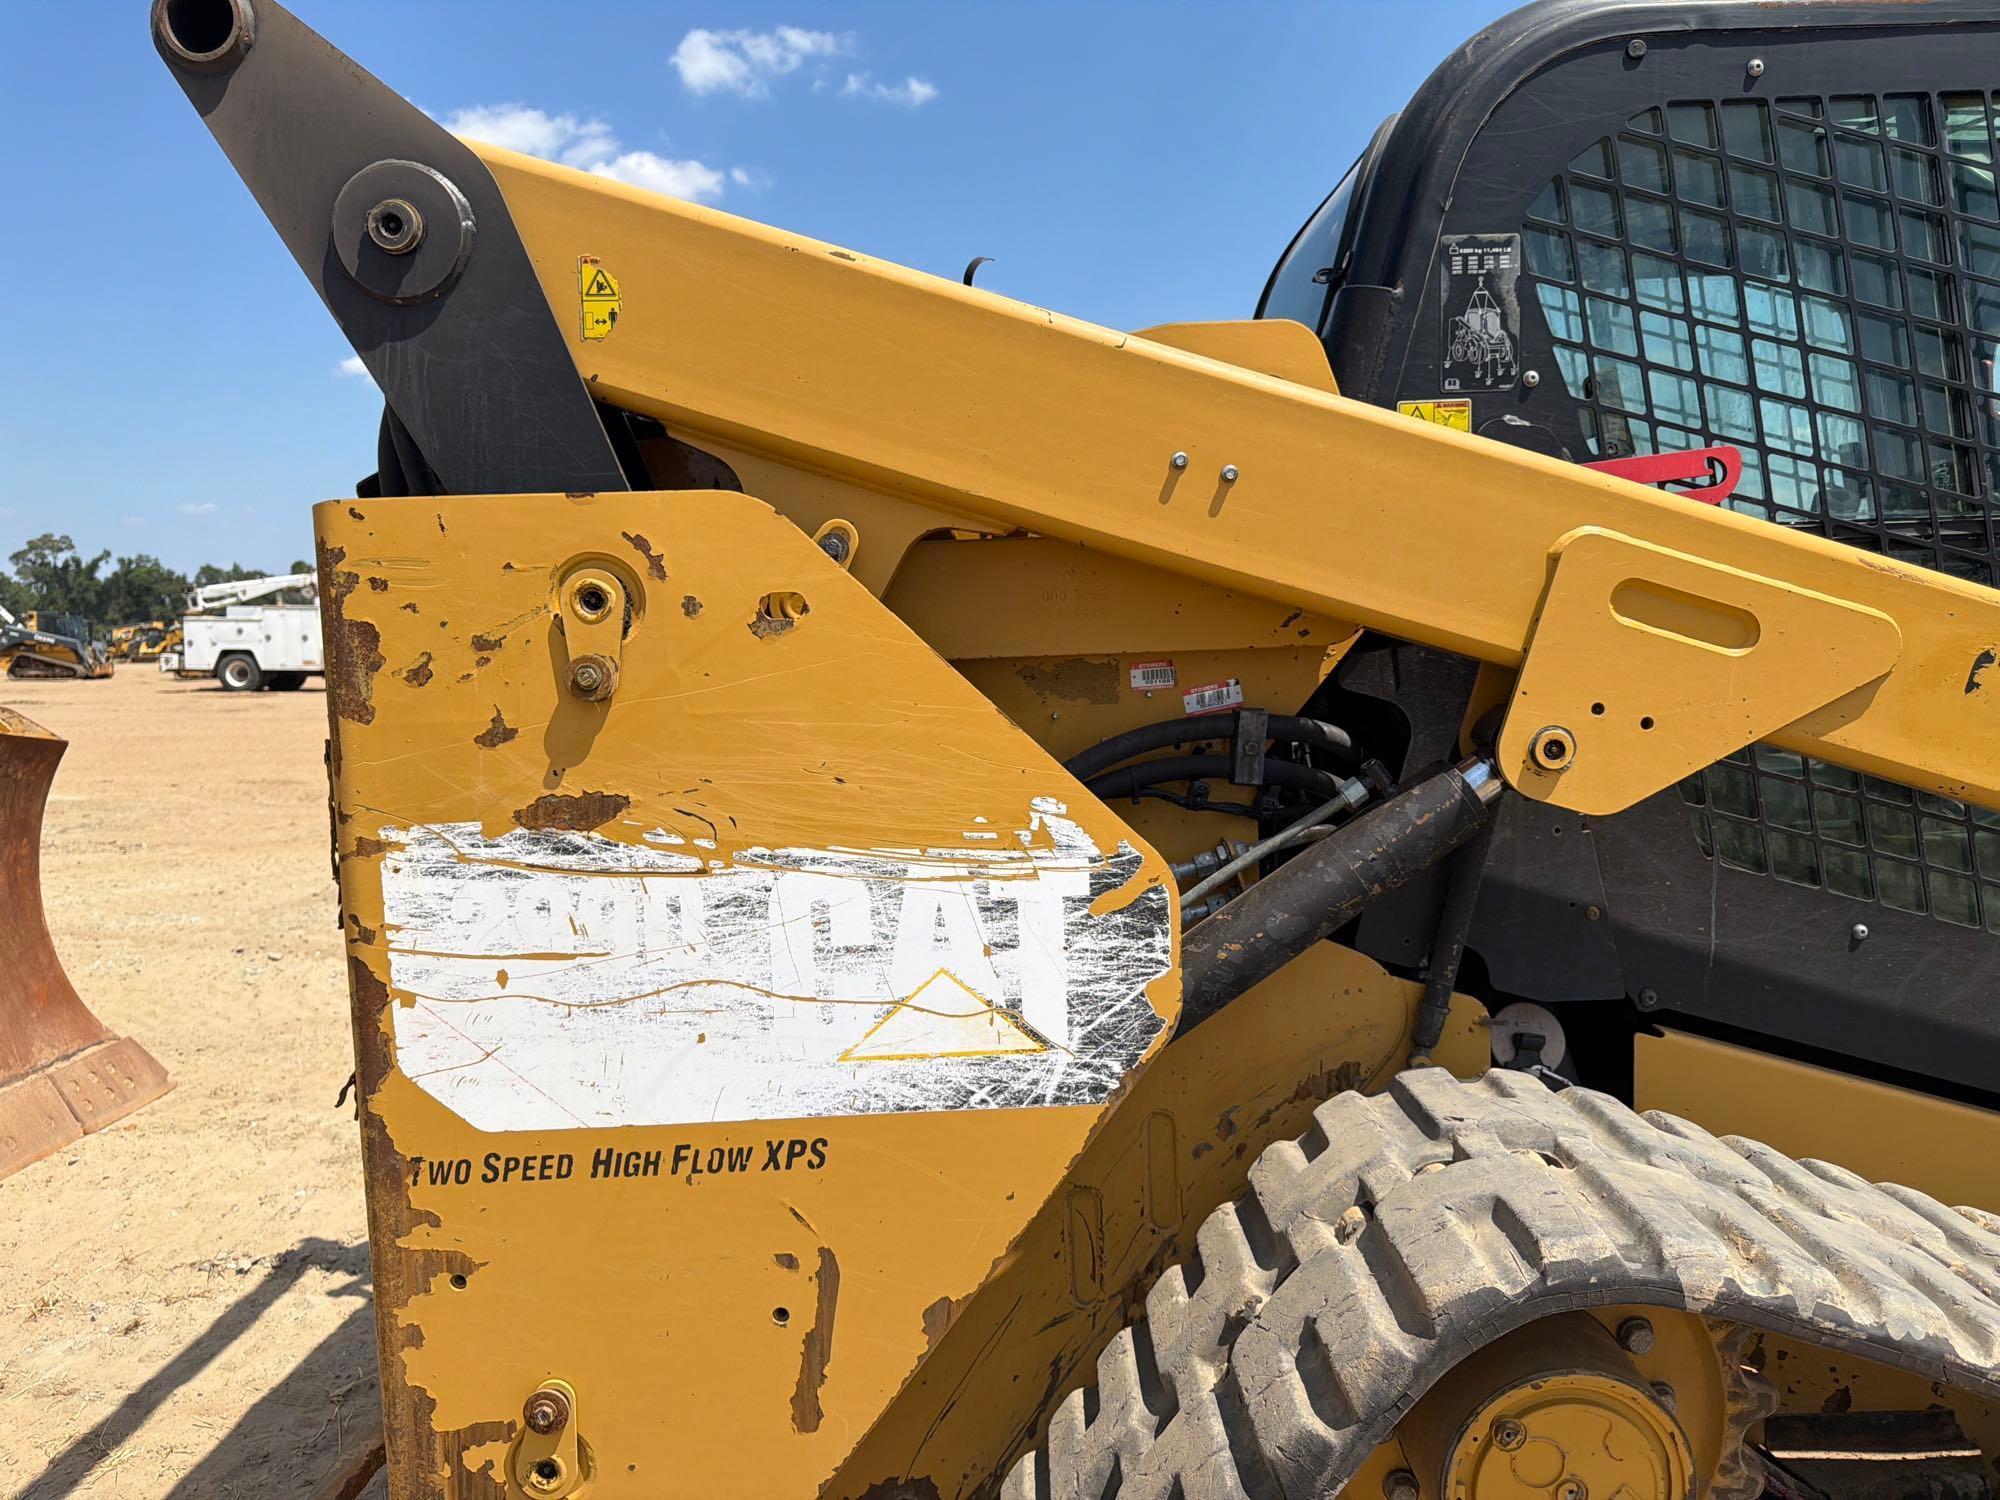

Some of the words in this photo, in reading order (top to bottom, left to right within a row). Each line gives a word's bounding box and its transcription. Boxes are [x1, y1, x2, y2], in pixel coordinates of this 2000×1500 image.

[1190, 684, 1219, 694] STOWERS
[768, 857, 1090, 1062] CAT
[409, 1156, 471, 1187] TWO
[481, 1152, 574, 1183] SPEED
[590, 1148, 662, 1179] HIGH
[671, 1143, 754, 1176] FLOW
[761, 1138, 829, 1172] XPS
